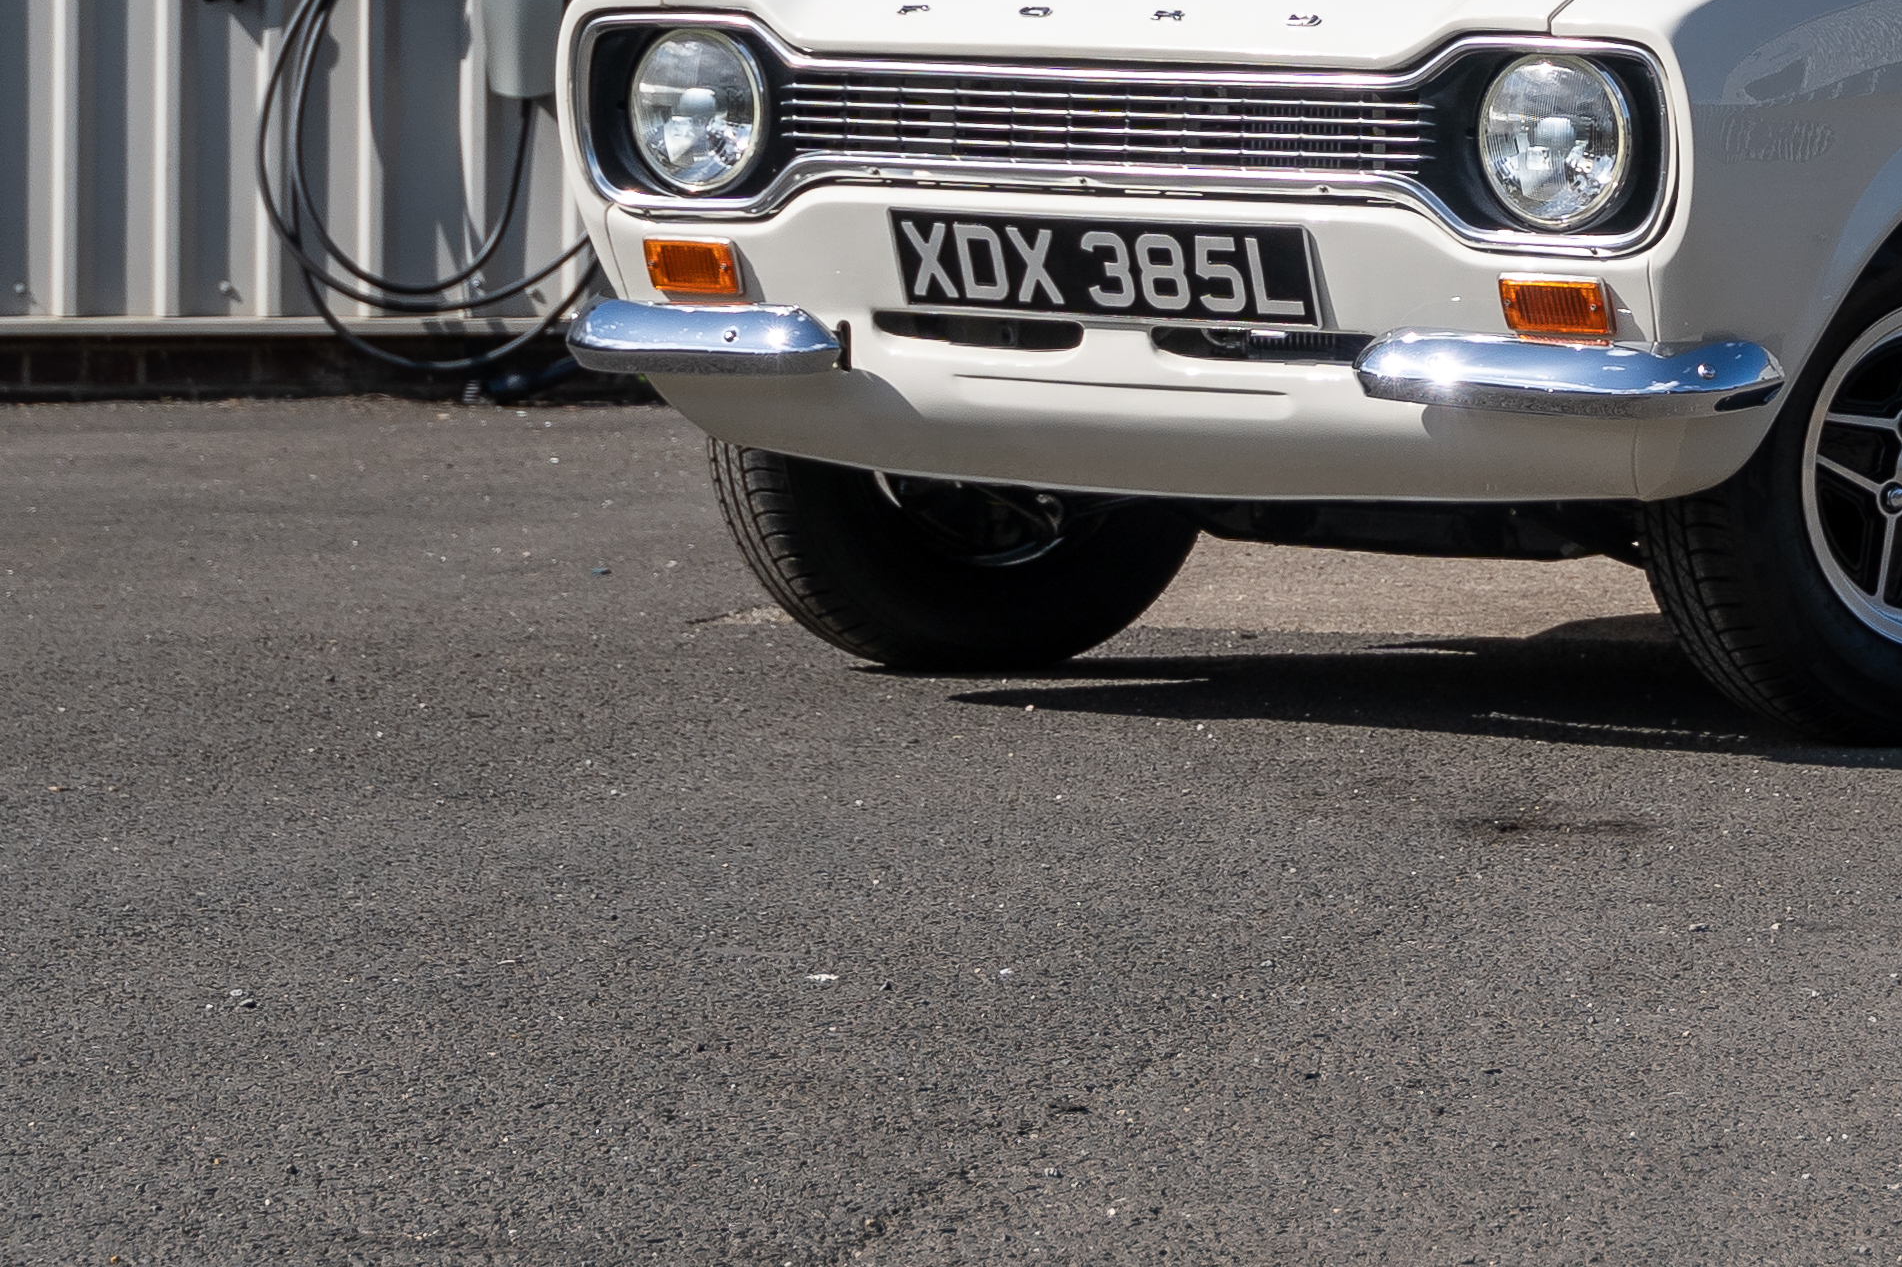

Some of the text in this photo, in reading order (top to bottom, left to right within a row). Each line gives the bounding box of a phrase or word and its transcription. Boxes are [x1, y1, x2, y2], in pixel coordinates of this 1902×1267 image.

[896, 3, 1324, 28] FORD
[900, 220, 1306, 317] XDX 385L
